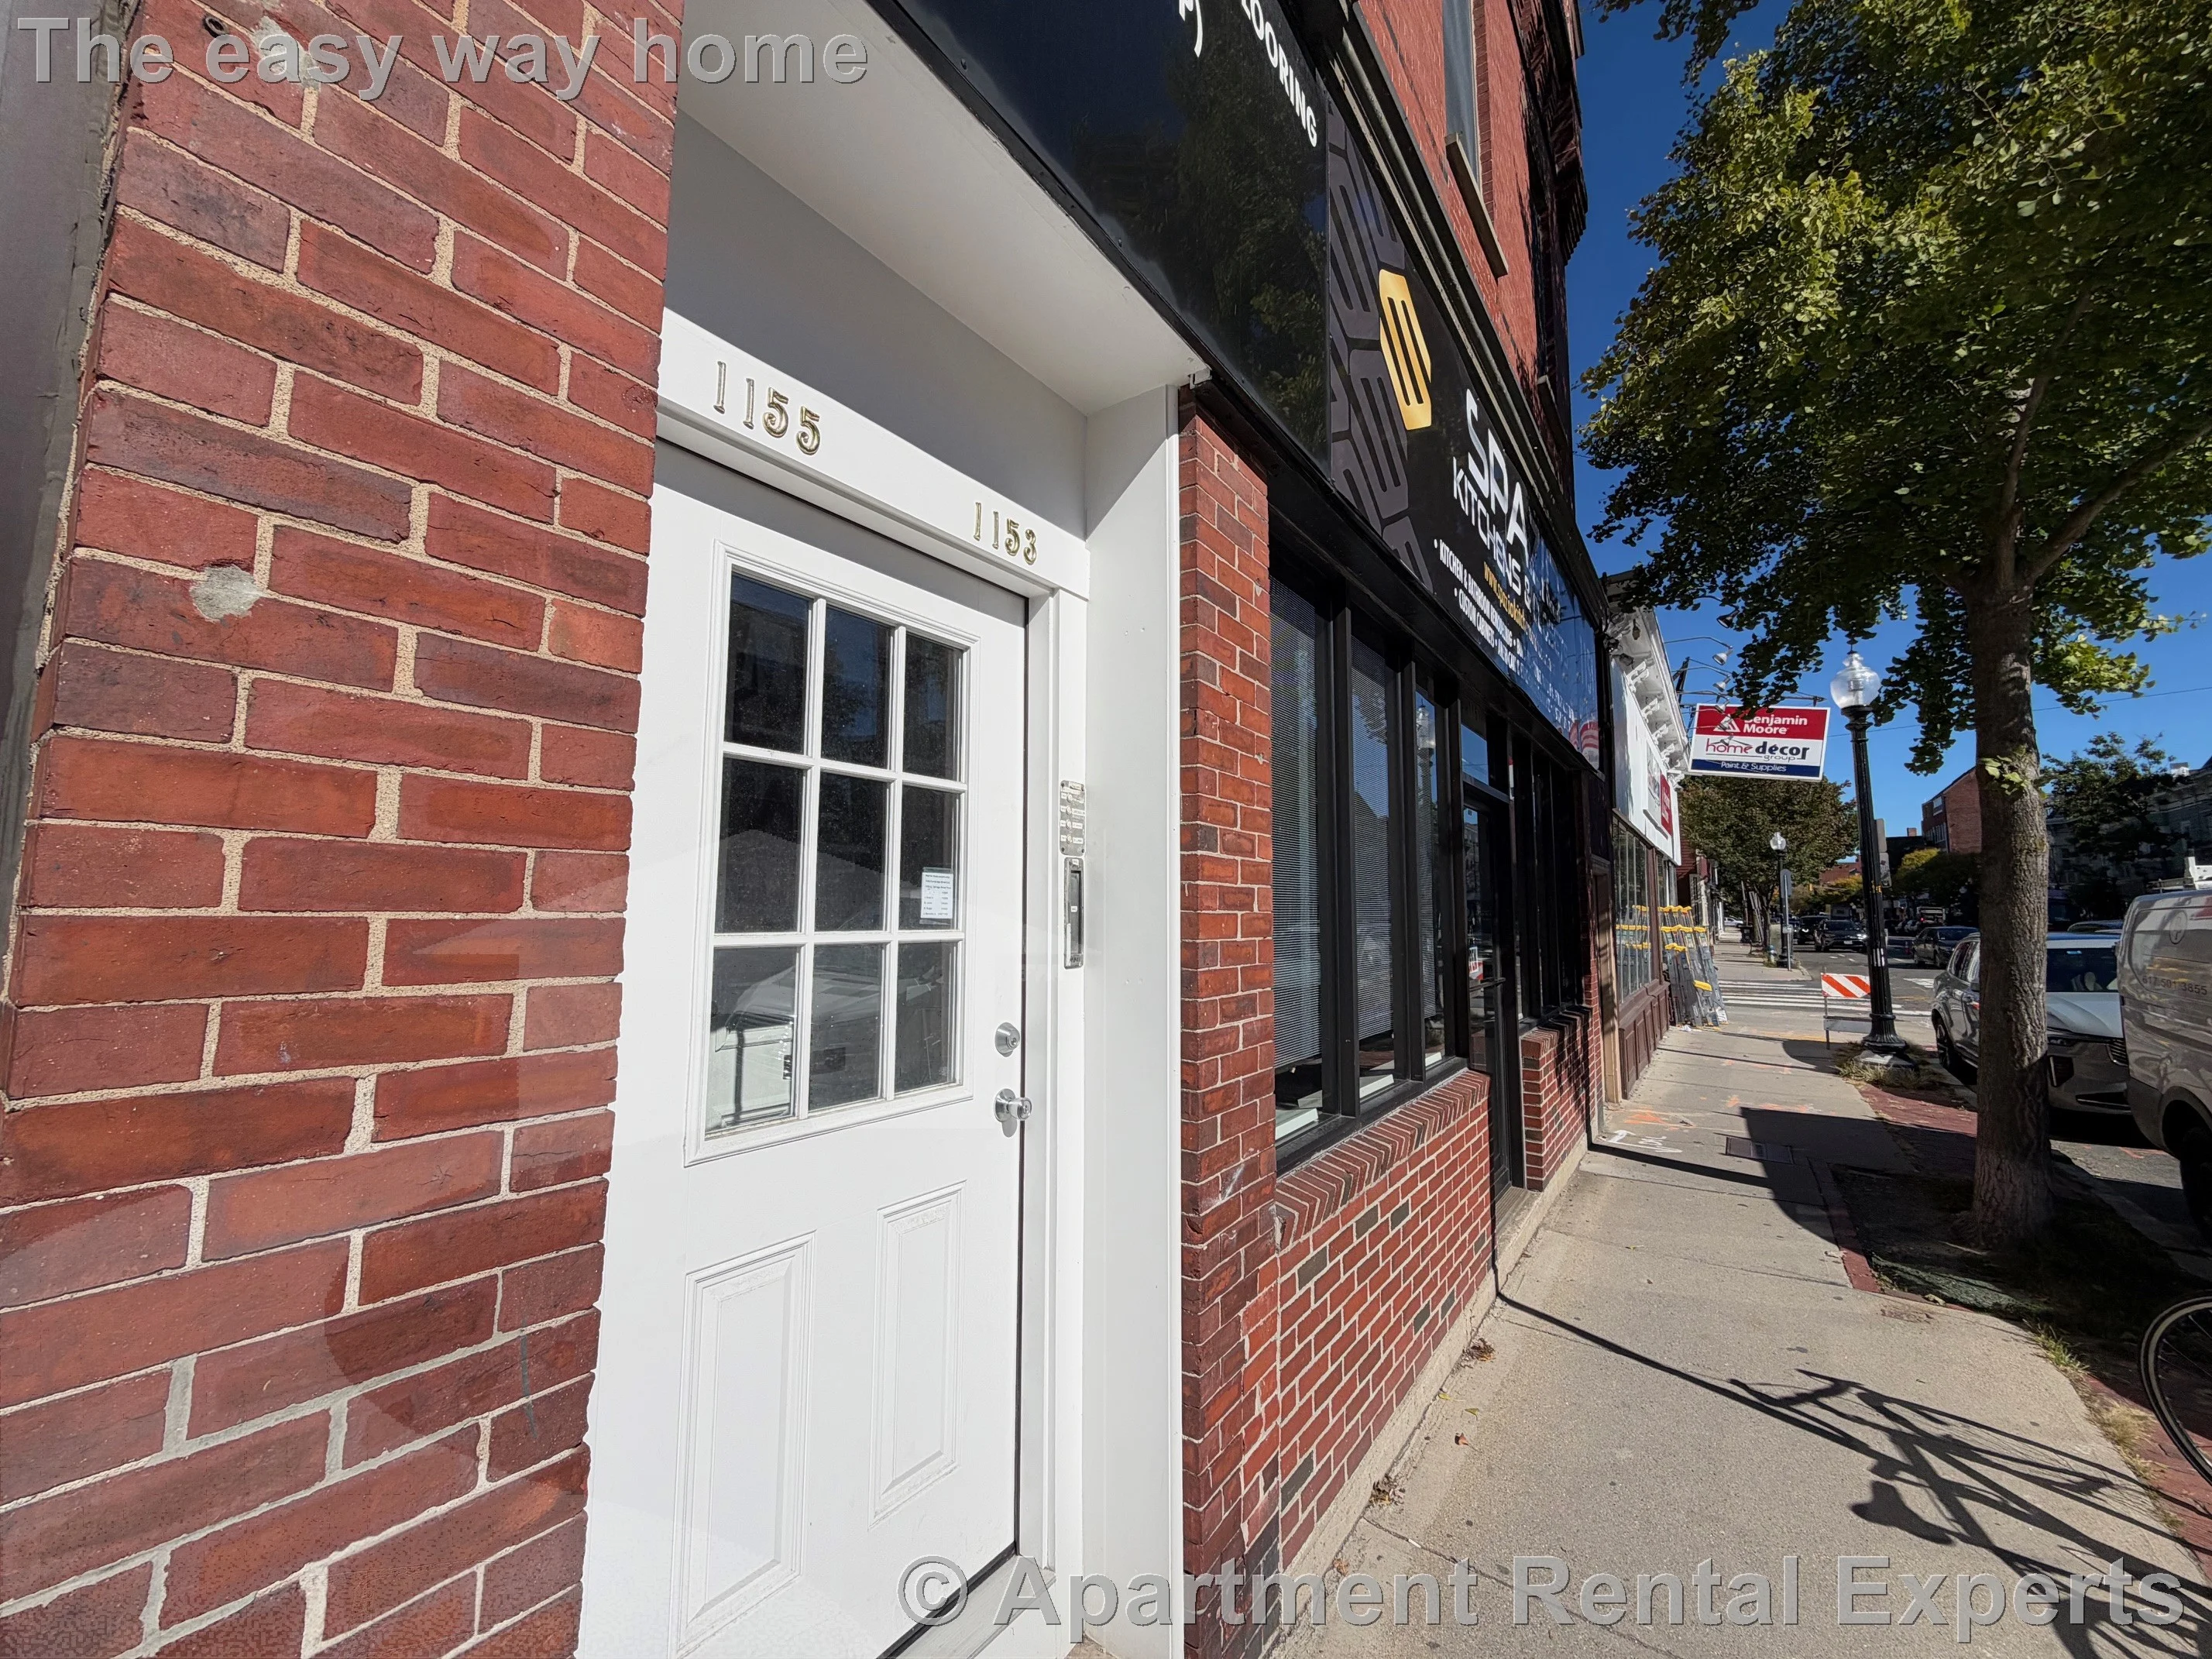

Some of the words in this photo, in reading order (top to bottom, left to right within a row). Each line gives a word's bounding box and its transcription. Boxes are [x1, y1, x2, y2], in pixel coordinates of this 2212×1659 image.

[1242, 0, 1317, 147] OORING
[713, 361, 821, 455] 1155
[973, 502, 1037, 565] 1153
[1453, 456, 1521, 596] KITCHENS
[1524, 575, 1532, 613] &
[1440, 539, 1464, 584] KITCHEN
[1468, 573, 1491, 620] BATHROOM
[1491, 602, 1513, 647] REMODELING
[1459, 589, 1477, 627] CUSTOM
[1477, 612, 1495, 648] CABINETS
[1743, 723, 1788, 735] Moore
[1744, 714, 1808, 726] enjamin
[1705, 738, 1753, 754] home
[1755, 740, 1810, 761] décor
[1721, 761, 1740, 769] Paint
[1741, 761, 1749, 770] &
[1751, 763, 1787, 772] Supplies
[1764, 754, 1796, 763] group
[2142, 977, 2158, 985] 617
